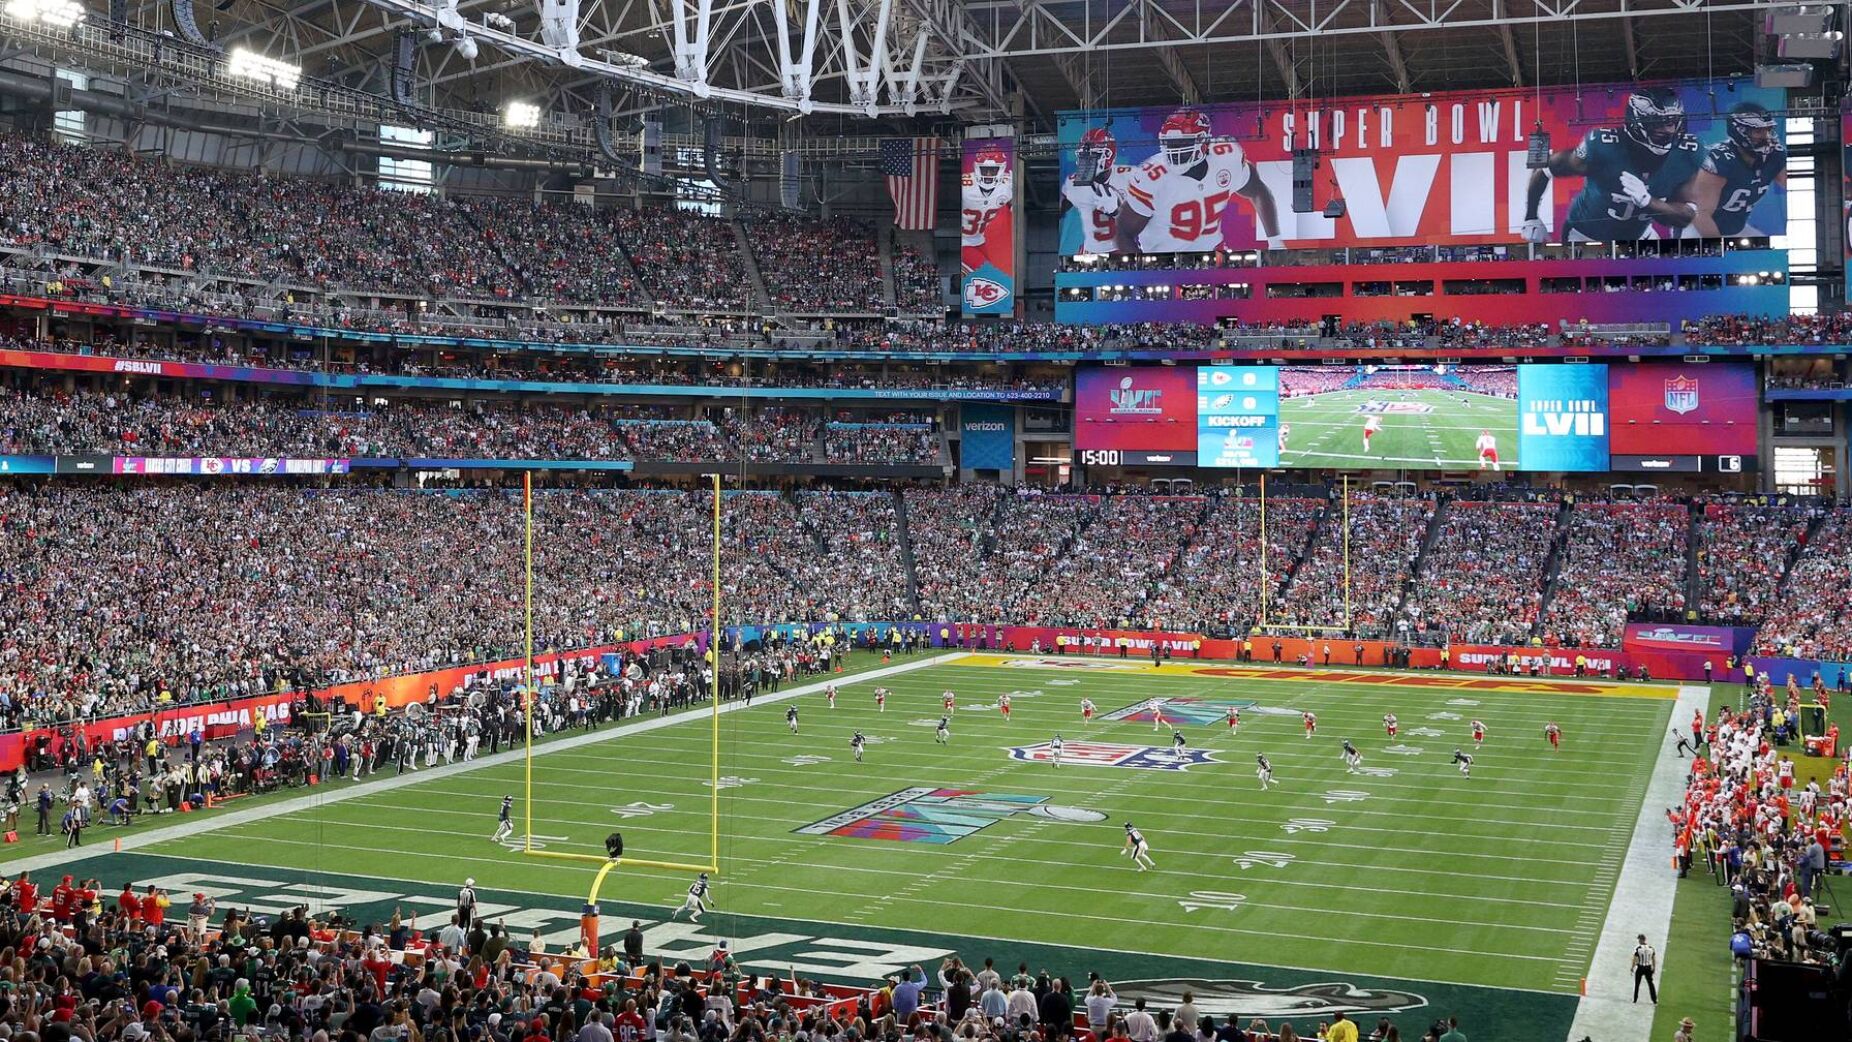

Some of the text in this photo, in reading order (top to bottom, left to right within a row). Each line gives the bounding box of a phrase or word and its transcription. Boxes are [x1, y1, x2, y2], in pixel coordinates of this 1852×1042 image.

[1283, 101, 1523, 151] SUPER BOWL
[1256, 149, 1553, 240] LVII
[1169, 190, 1230, 241] 95
[975, 284, 998, 301] KC
[114, 361, 161, 374] #SBLVII
[1668, 394, 1695, 407] NFL
[965, 420, 1005, 431] verizon
[1208, 416, 1265, 427] KICKOFF
[1523, 412, 1604, 436] LVII
[231, 459, 251, 472] VS
[1082, 450, 1118, 465] 15:00
[1191, 668, 1617, 694] CHIEFS
[1233, 852, 1296, 868] 20
[1178, 891, 1246, 911] 10
